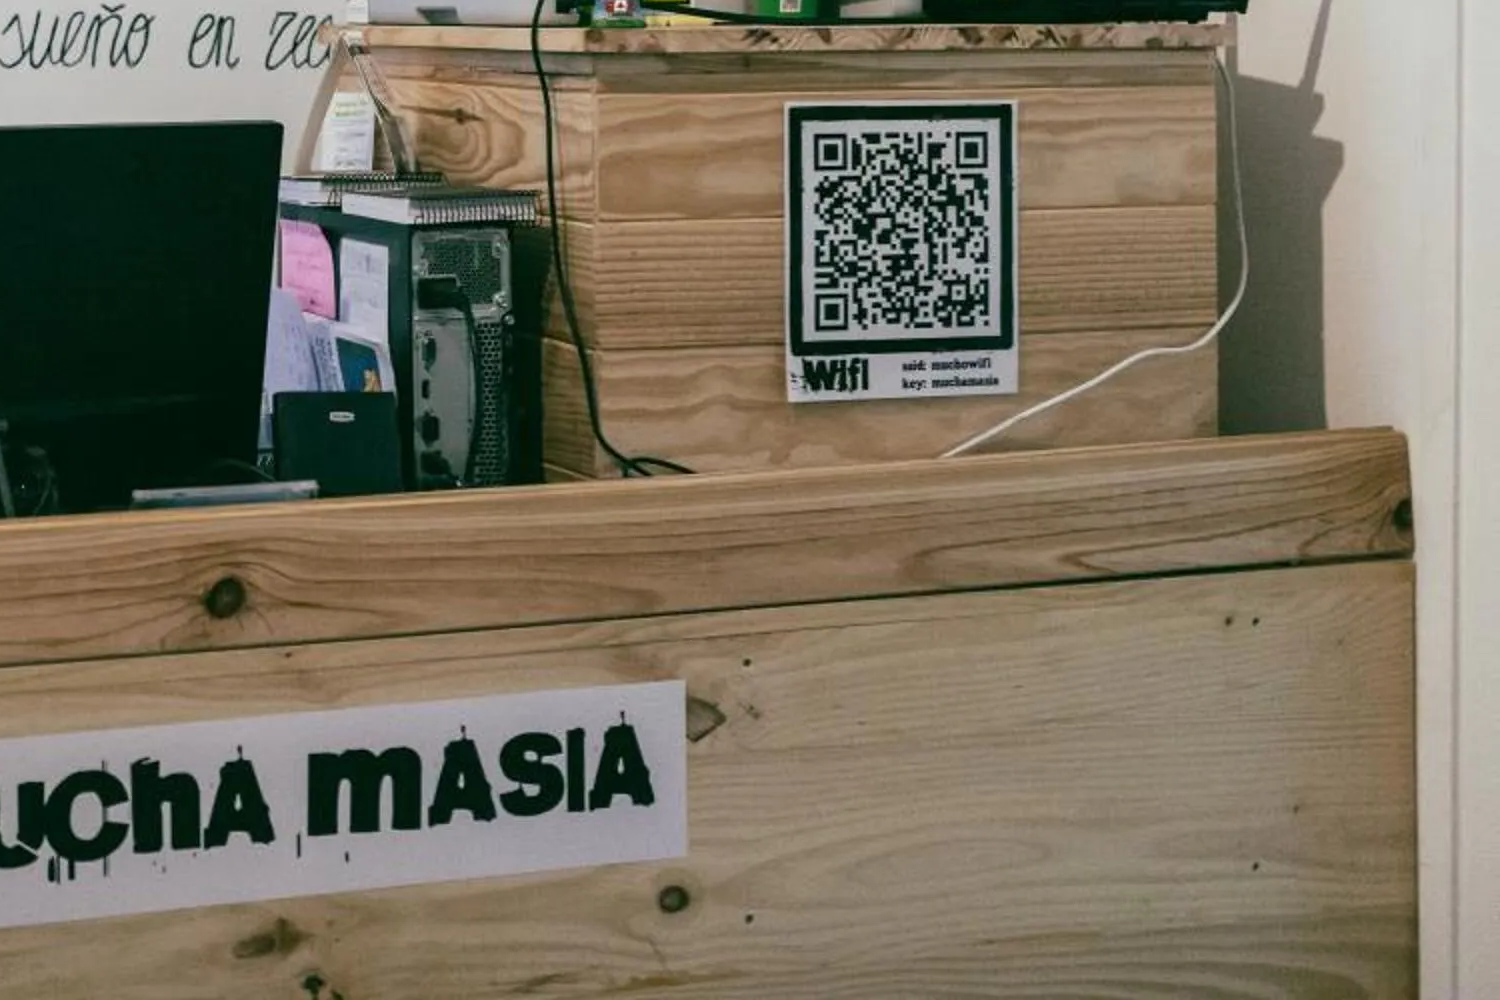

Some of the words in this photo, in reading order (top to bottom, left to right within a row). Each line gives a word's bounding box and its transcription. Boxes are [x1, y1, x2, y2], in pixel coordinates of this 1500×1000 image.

[187, 11, 241, 70] en
[802, 357, 869, 391] Wifi
[902, 377, 927, 391] key:
